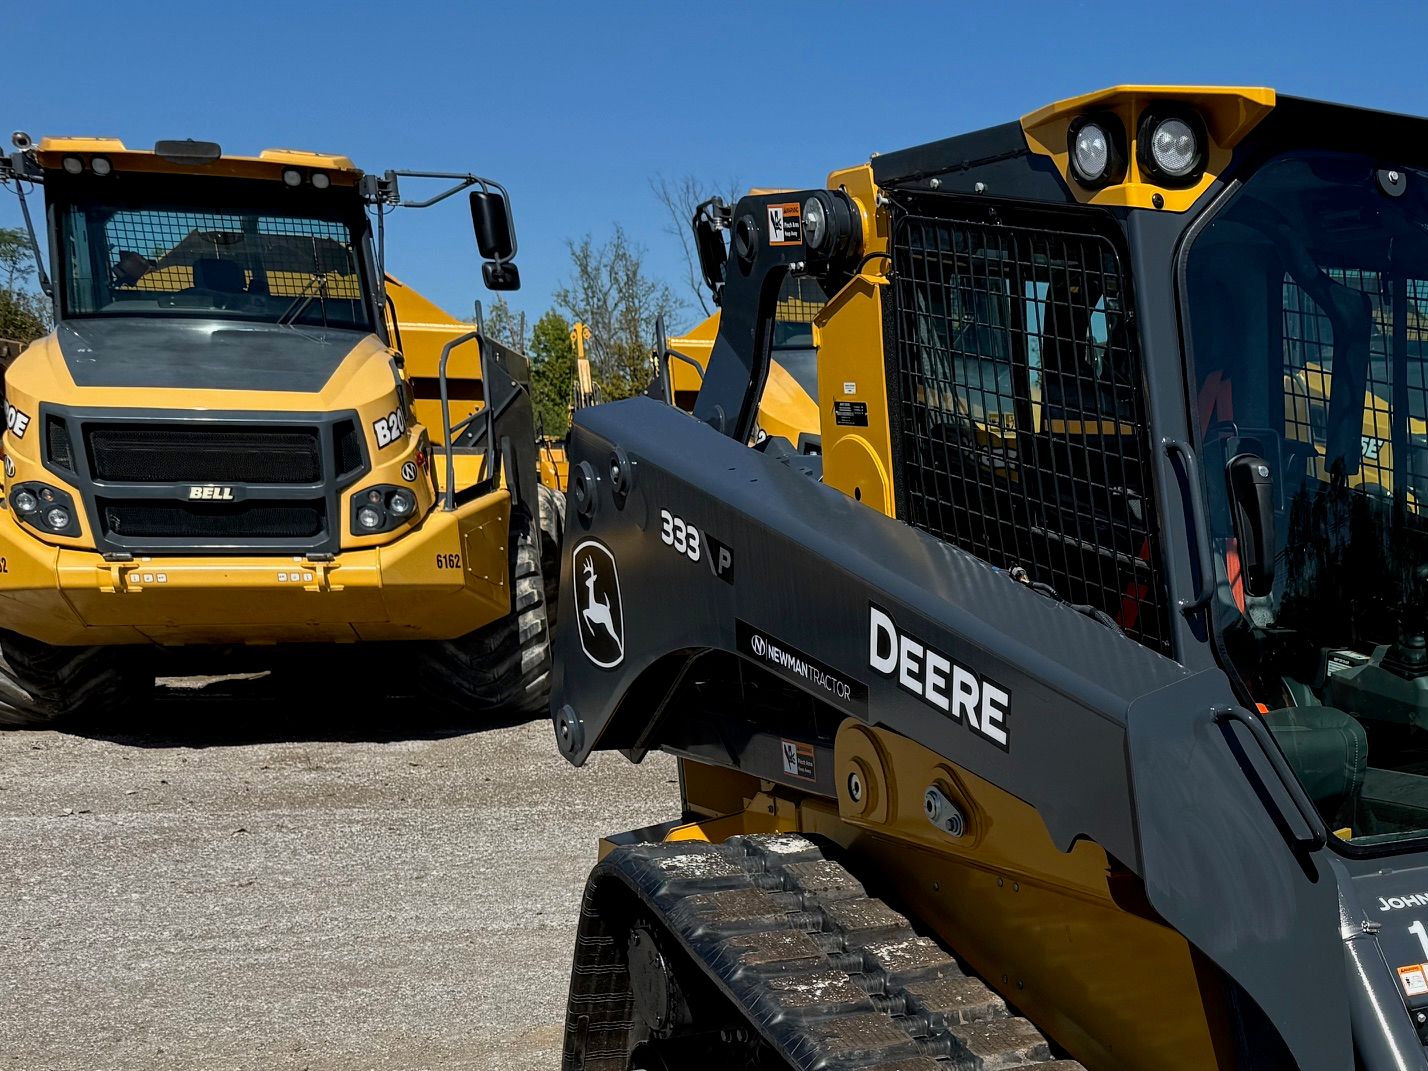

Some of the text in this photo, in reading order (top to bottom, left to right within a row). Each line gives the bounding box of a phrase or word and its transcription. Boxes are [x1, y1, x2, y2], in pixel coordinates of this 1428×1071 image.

[188, 486, 234, 500] BELL
[436, 554, 461, 569] 6162
[660, 509, 732, 574] 333 P
[869, 606, 1009, 746] DEERE
